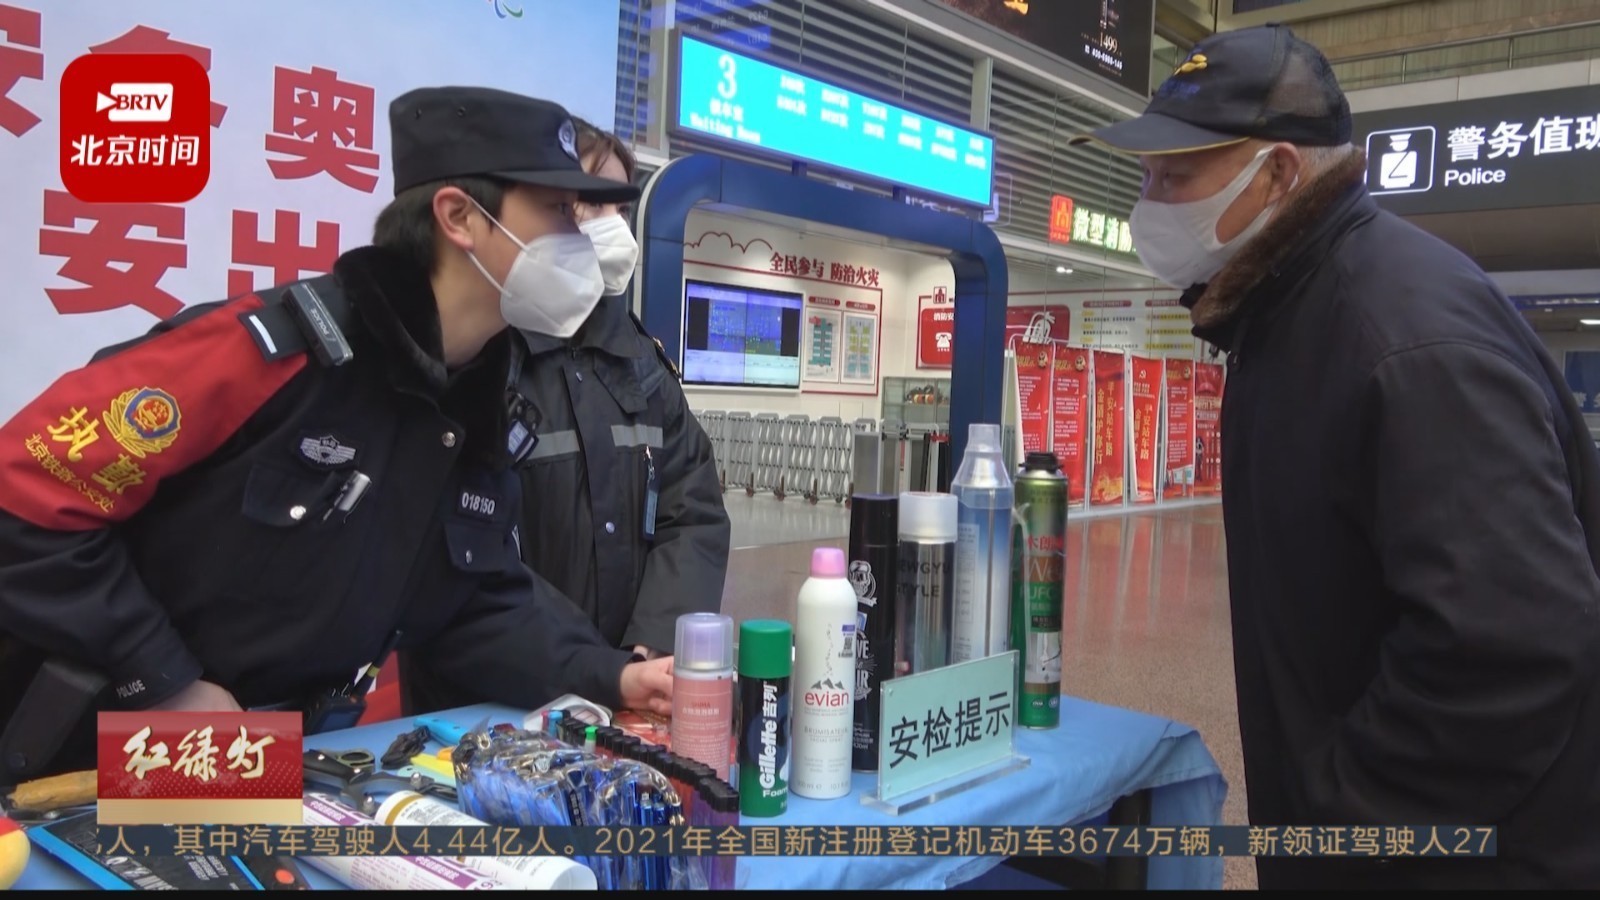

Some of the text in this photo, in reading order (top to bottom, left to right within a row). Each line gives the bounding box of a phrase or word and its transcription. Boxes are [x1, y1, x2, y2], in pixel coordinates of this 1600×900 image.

[717, 54, 738, 99] 3
[1444, 168, 1507, 187] Police
[1073, 207, 1136, 253] 微型消防
[769, 251, 880, 287] 全民参与 防治火灾
[47, 406, 147, 496] 执勤
[461, 491, 496, 515] 018150
[116, 679, 146, 700] POLICE
[804, 691, 850, 707] evian
[759, 682, 778, 790] Gillette 吉列
[889, 690, 1011, 769] 安检提示
